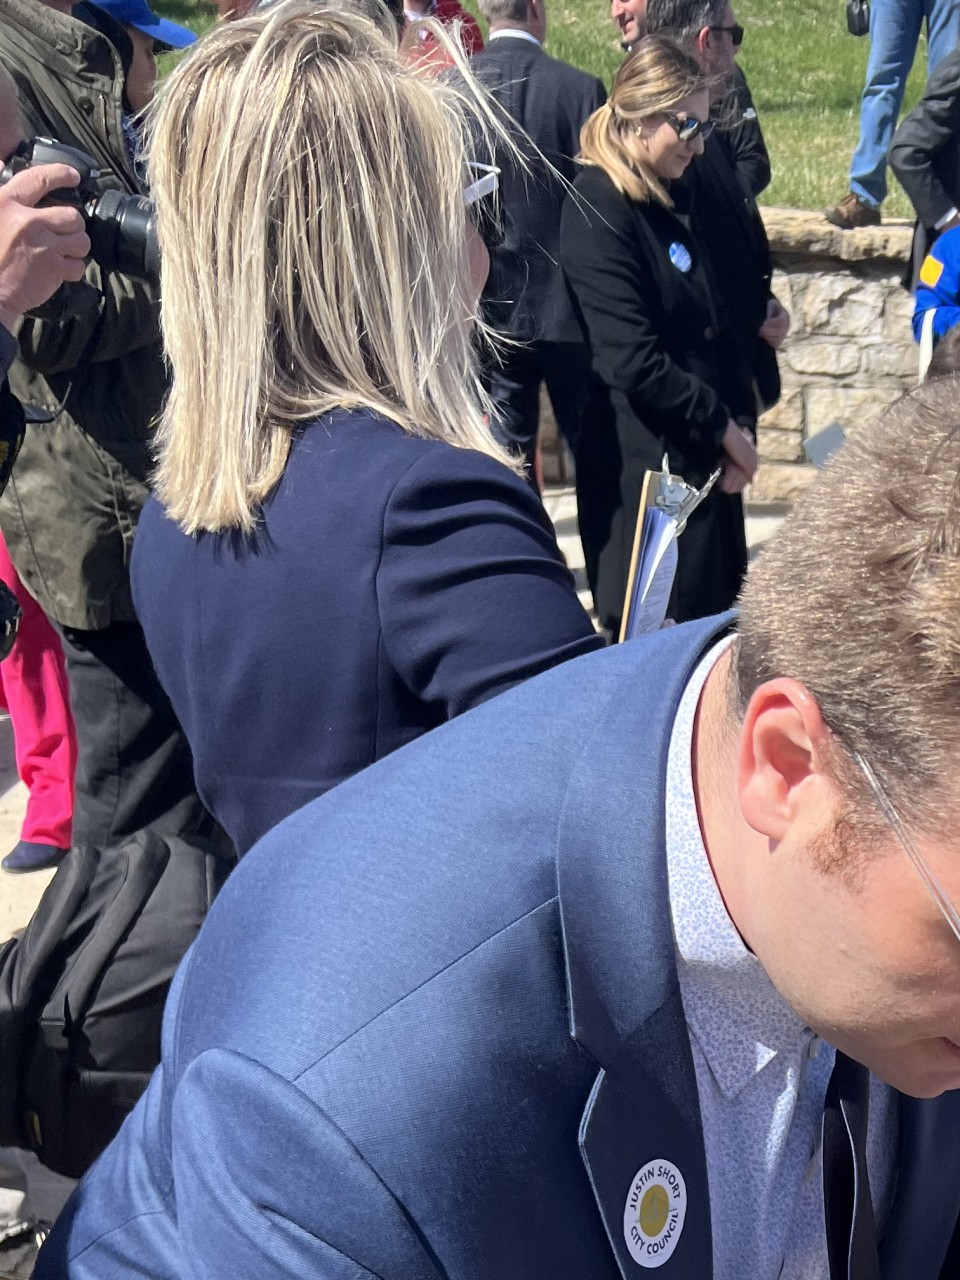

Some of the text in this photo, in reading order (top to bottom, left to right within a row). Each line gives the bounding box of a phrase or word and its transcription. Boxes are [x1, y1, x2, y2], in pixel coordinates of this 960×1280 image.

[630, 1166, 681, 1211] JUSTIN SHORT
[630, 1212, 679, 1256] CITY COUNCIL
